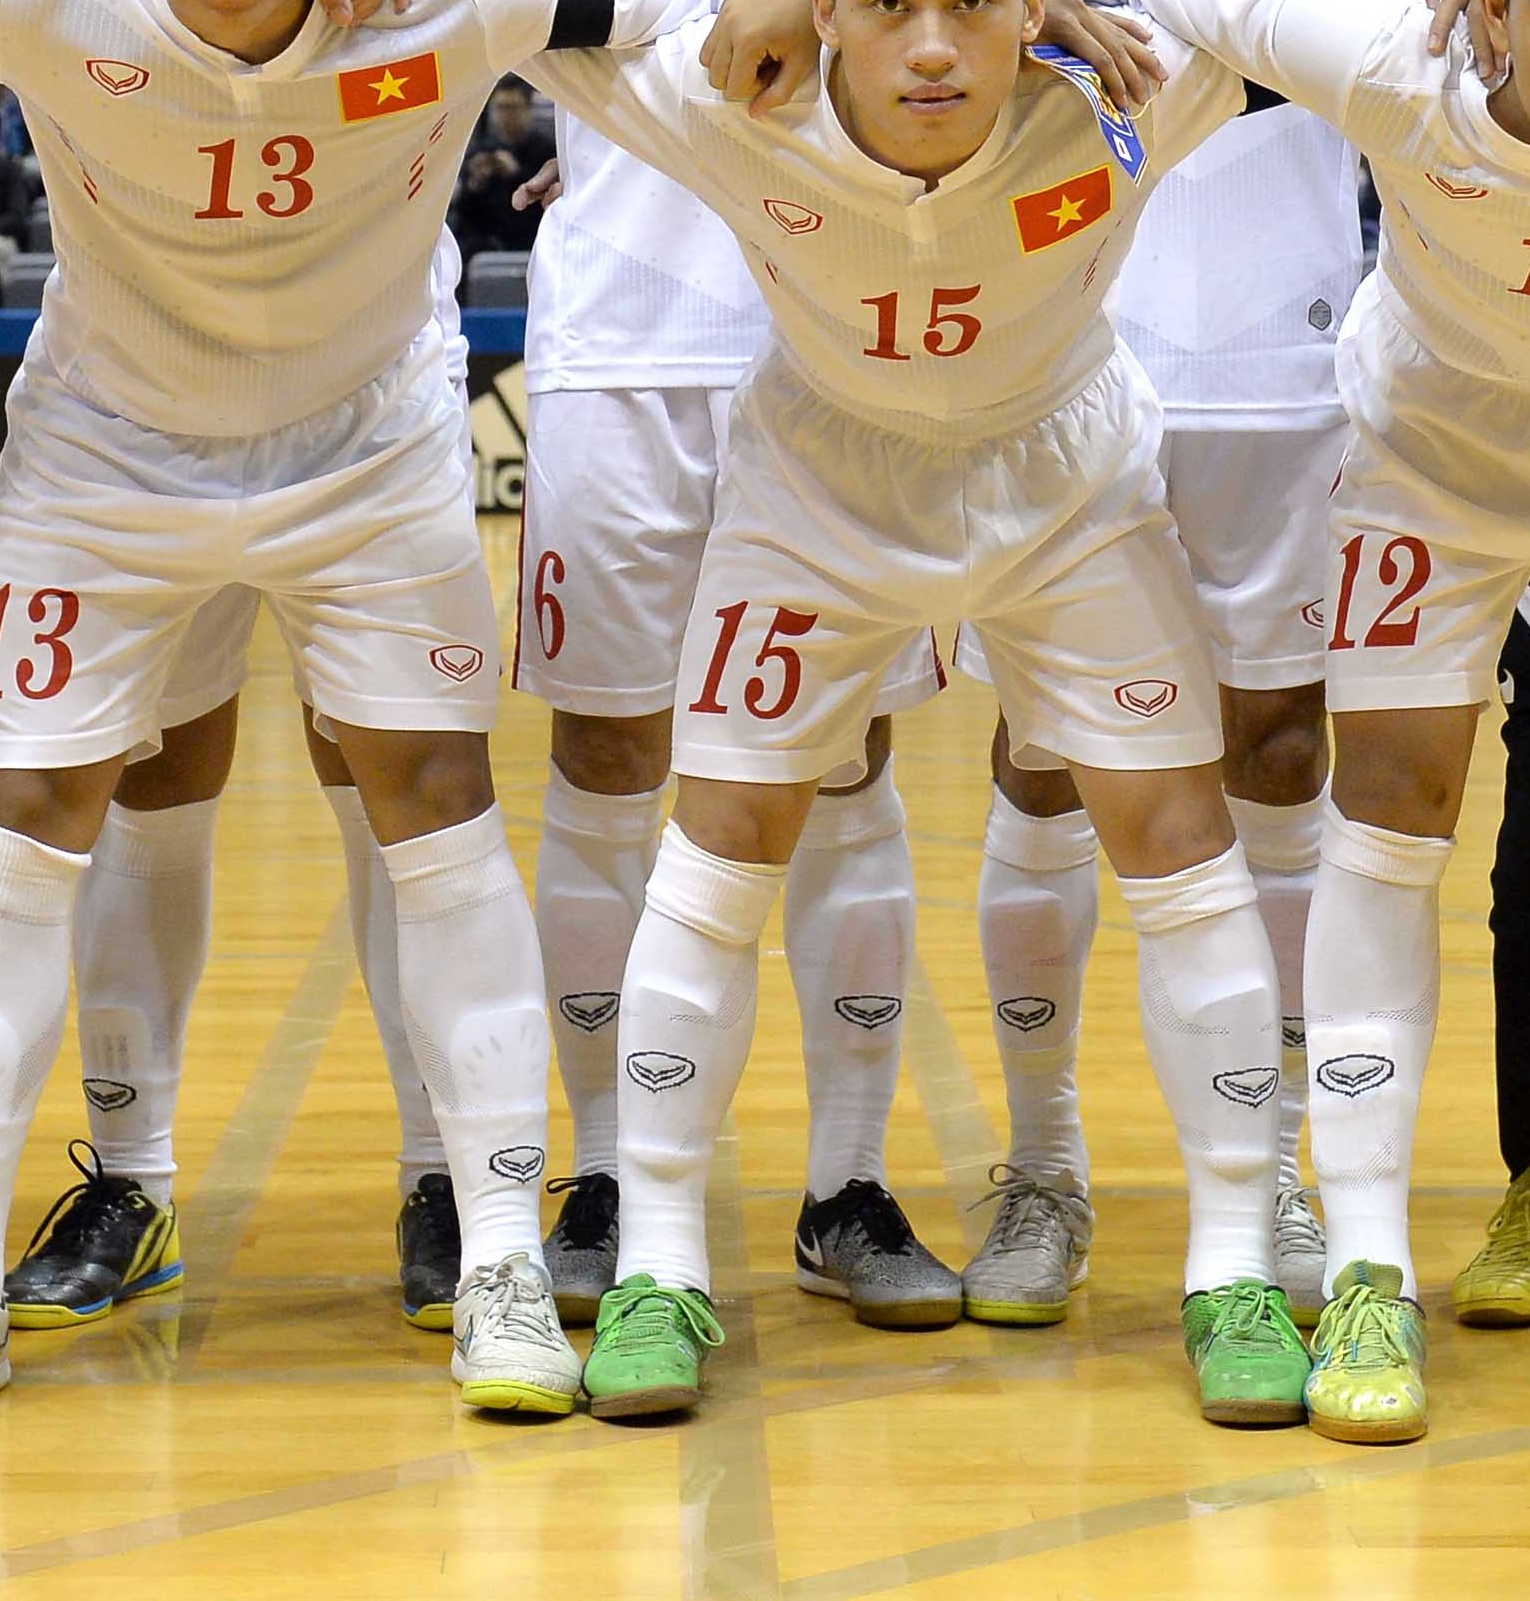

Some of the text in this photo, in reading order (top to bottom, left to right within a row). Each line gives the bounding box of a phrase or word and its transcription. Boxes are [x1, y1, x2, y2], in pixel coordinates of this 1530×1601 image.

[194, 135, 315, 220] 13
[861, 285, 982, 360] 15
[534, 550, 565, 661] 6
[1328, 534, 1431, 650] 12
[688, 600, 819, 719] 15
